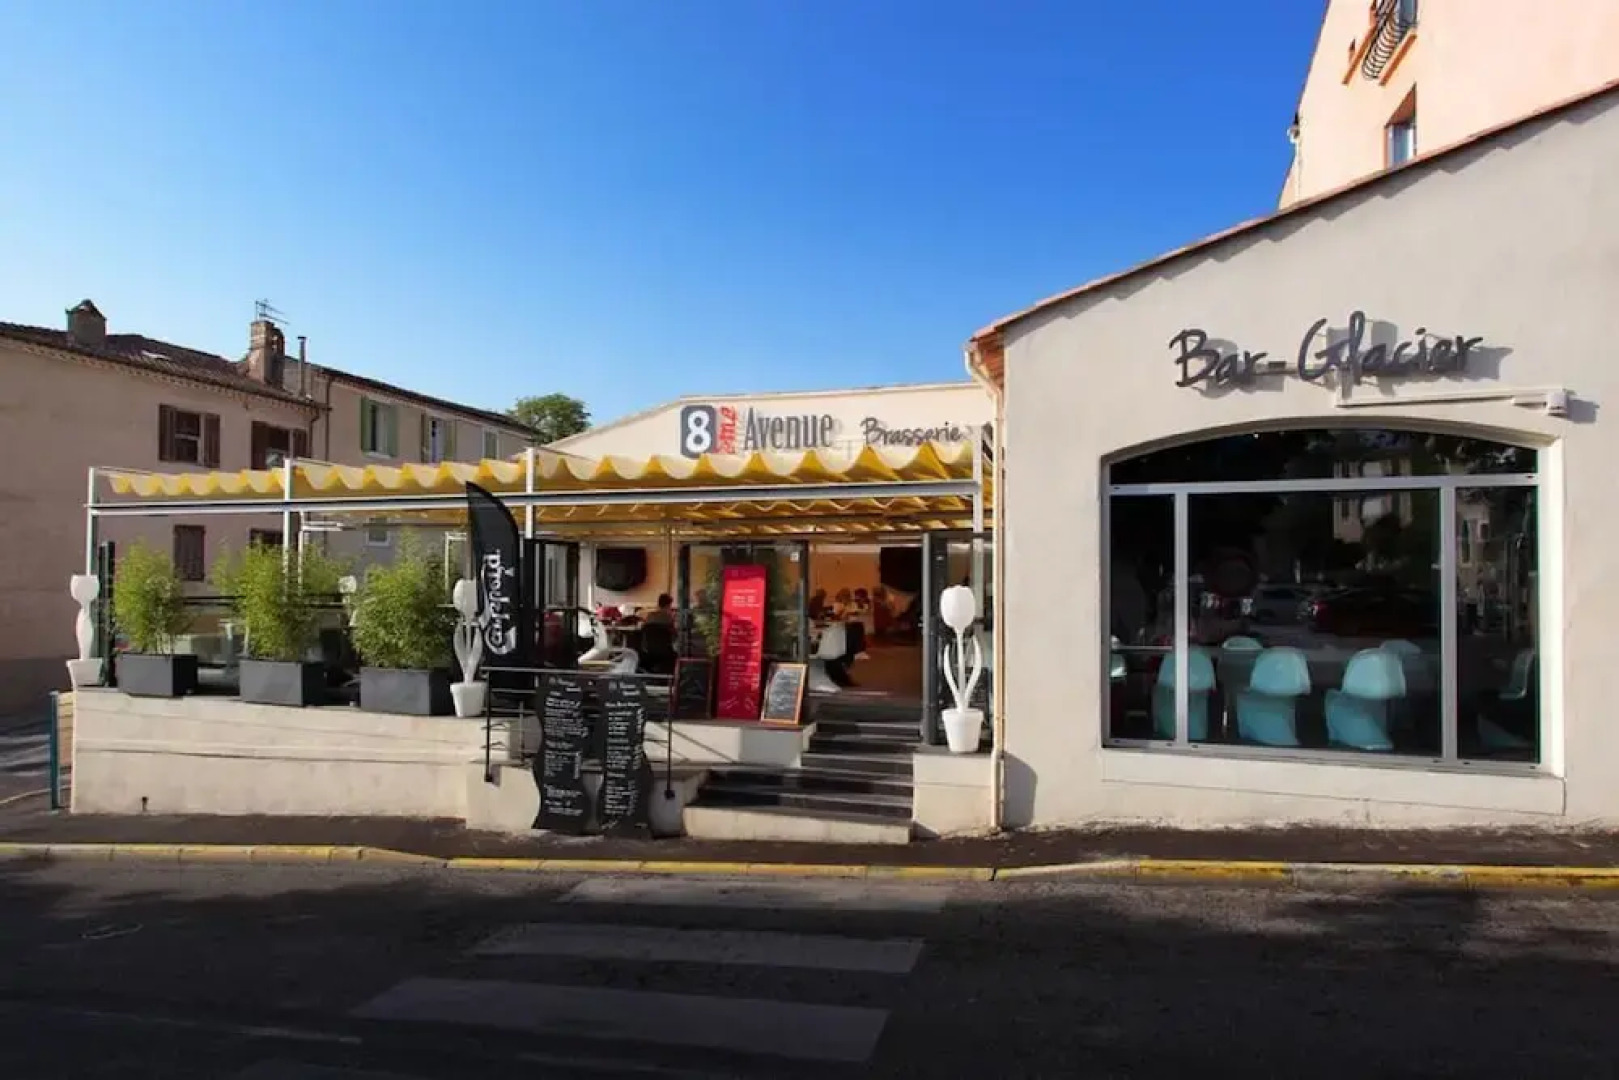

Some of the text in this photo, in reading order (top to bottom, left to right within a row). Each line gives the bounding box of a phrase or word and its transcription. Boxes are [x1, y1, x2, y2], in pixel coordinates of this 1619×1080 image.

[685, 410, 712, 454] 8
[743, 406, 833, 451] Avenue
[859, 416, 962, 446] Brasserie
